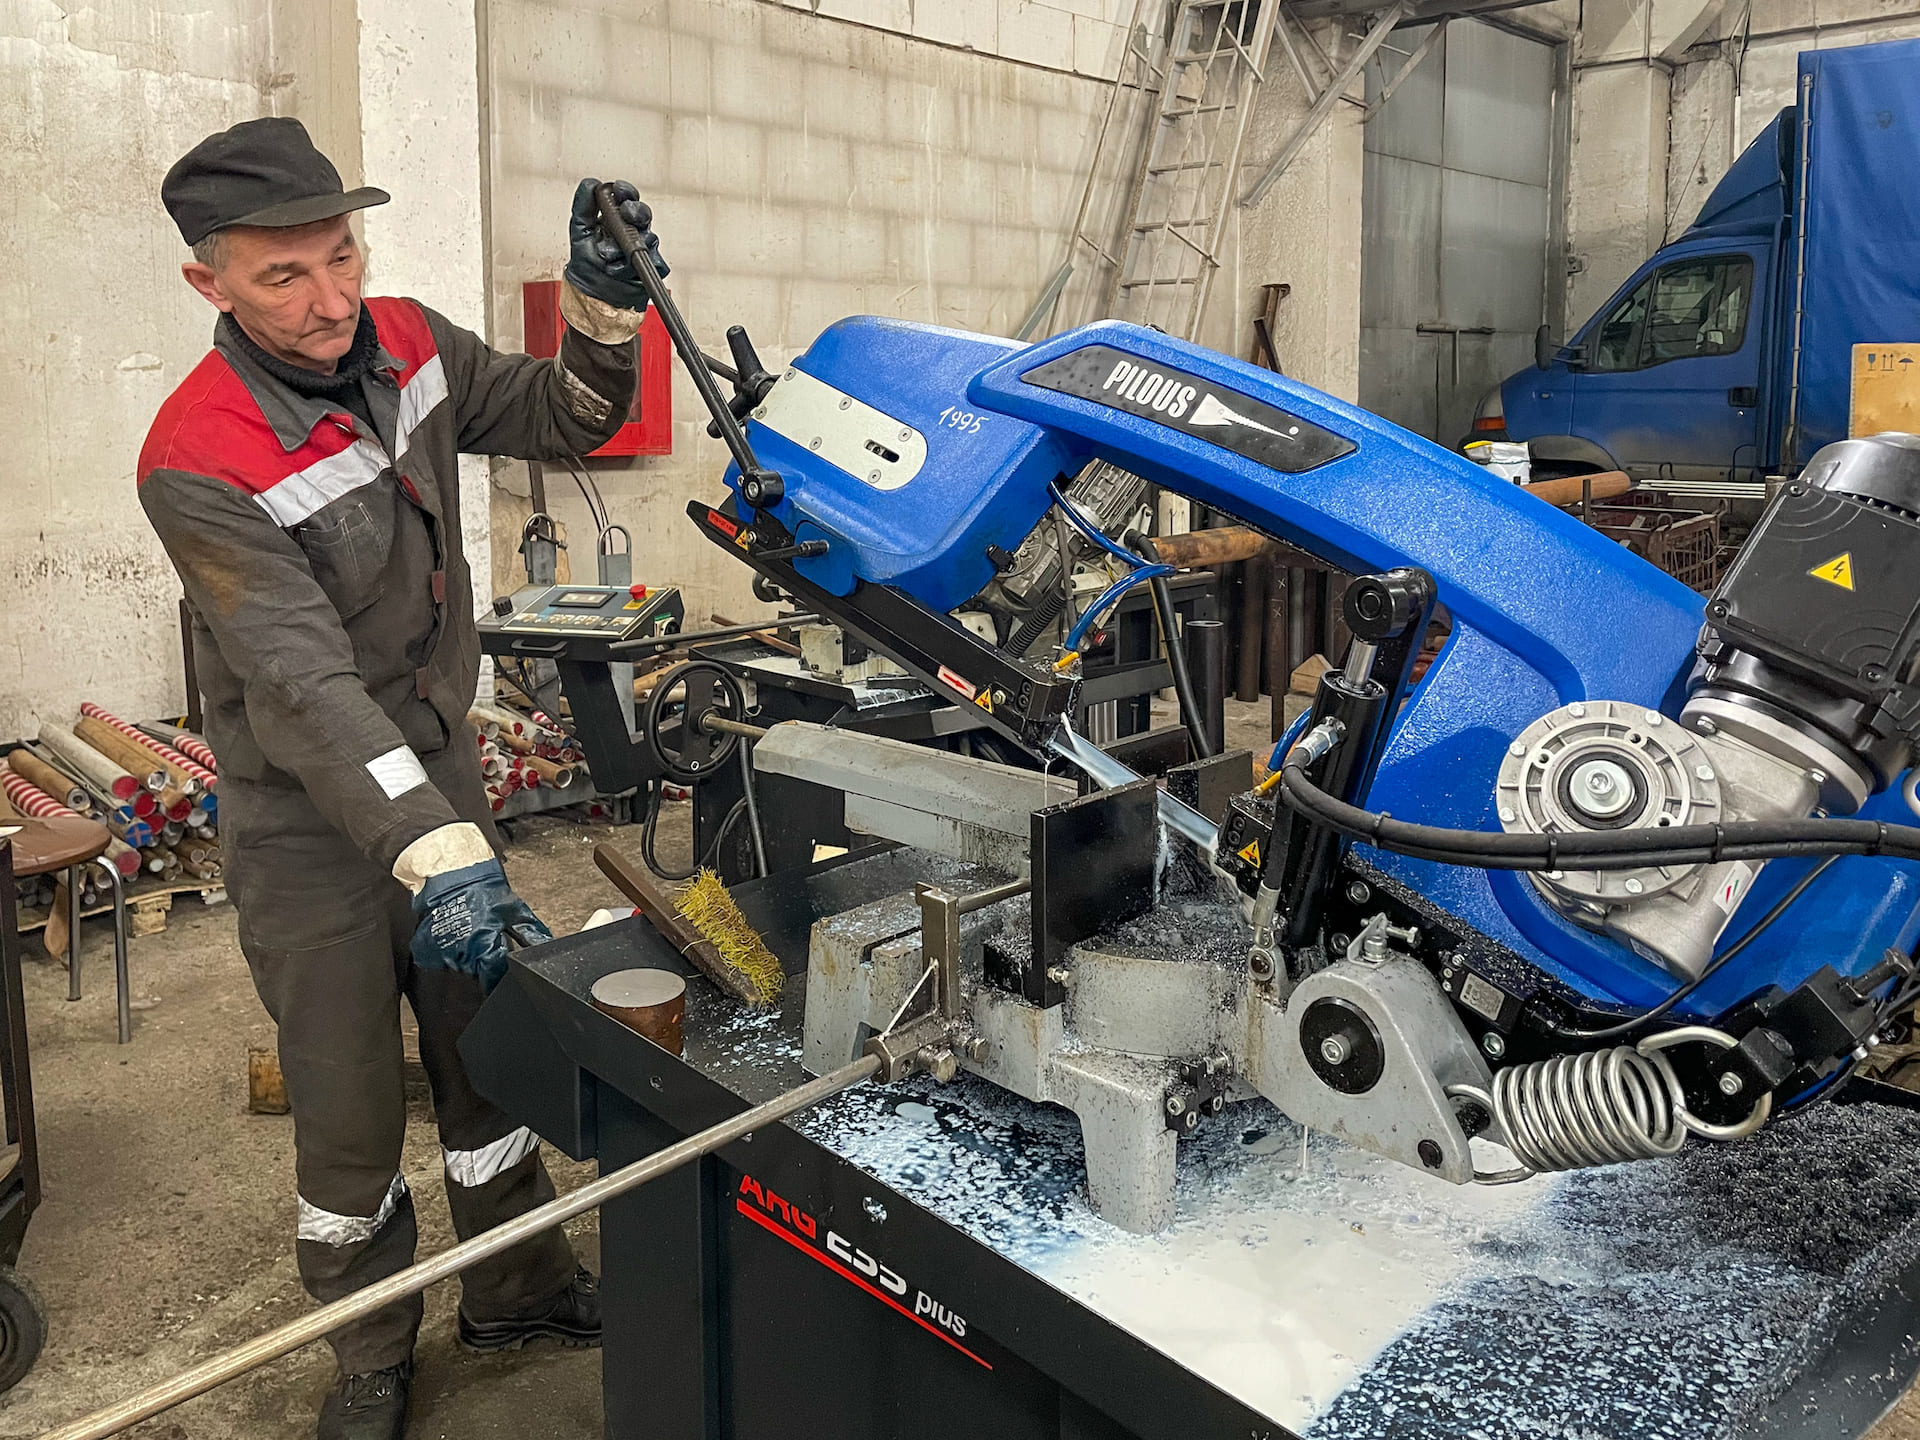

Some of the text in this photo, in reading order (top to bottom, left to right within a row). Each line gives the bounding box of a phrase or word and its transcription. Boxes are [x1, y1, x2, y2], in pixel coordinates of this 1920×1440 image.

[1102, 360, 1197, 418] PILOUS
[938, 405, 990, 434] 1995
[739, 1173, 817, 1240] ARG
[914, 1290, 967, 1337] plus
